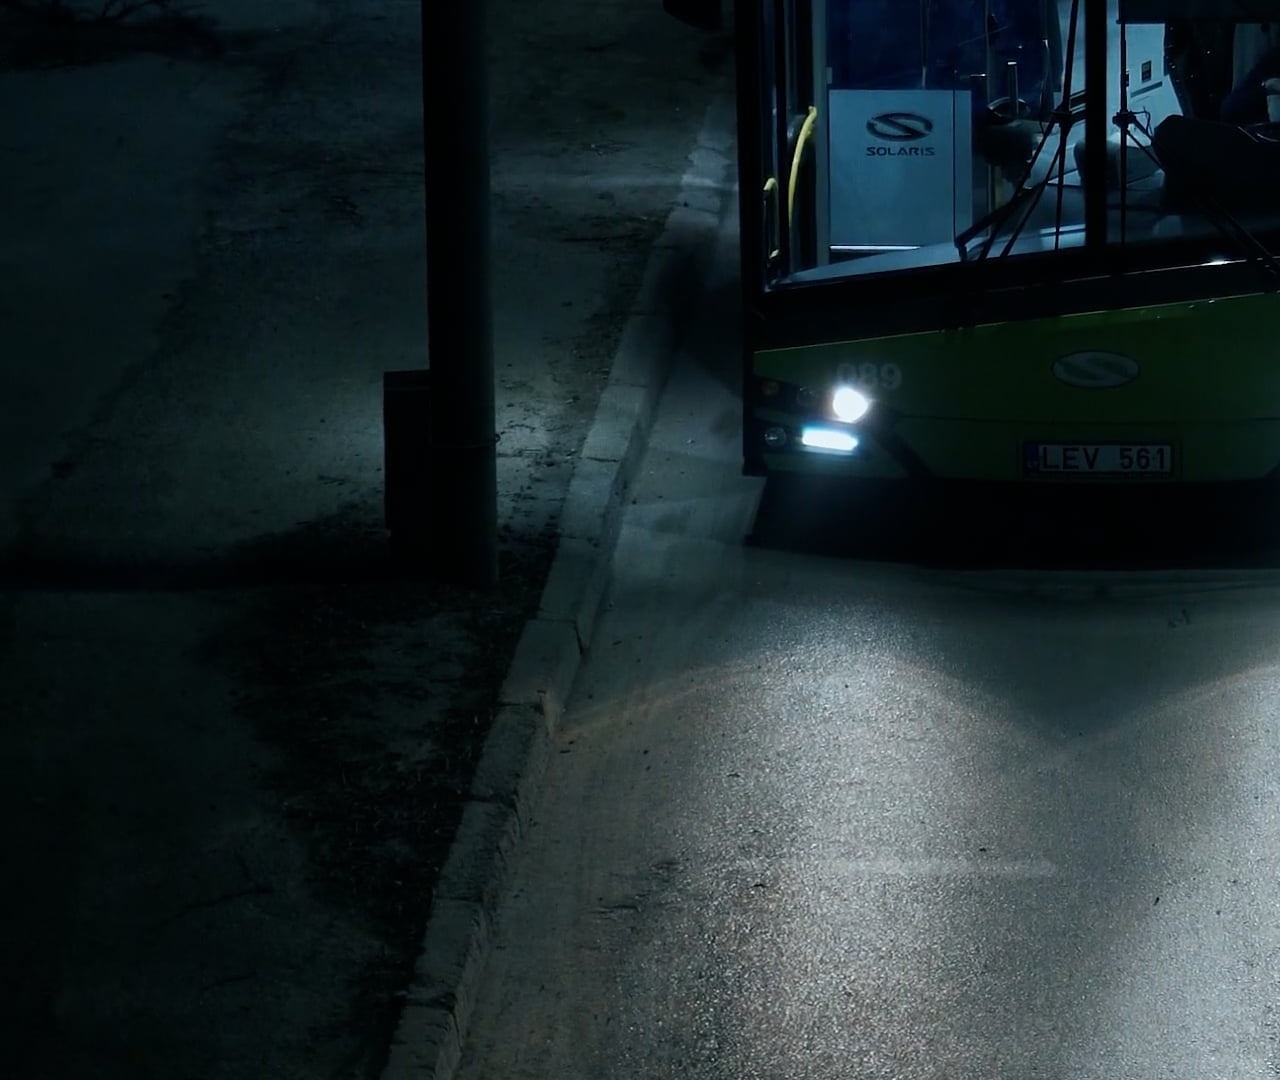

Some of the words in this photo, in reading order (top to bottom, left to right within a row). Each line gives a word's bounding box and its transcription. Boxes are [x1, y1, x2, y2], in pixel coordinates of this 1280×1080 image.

[866, 146, 936, 157] SOLARIS
[1042, 446, 1100, 470] LEV
[1119, 446, 1165, 470] 561
